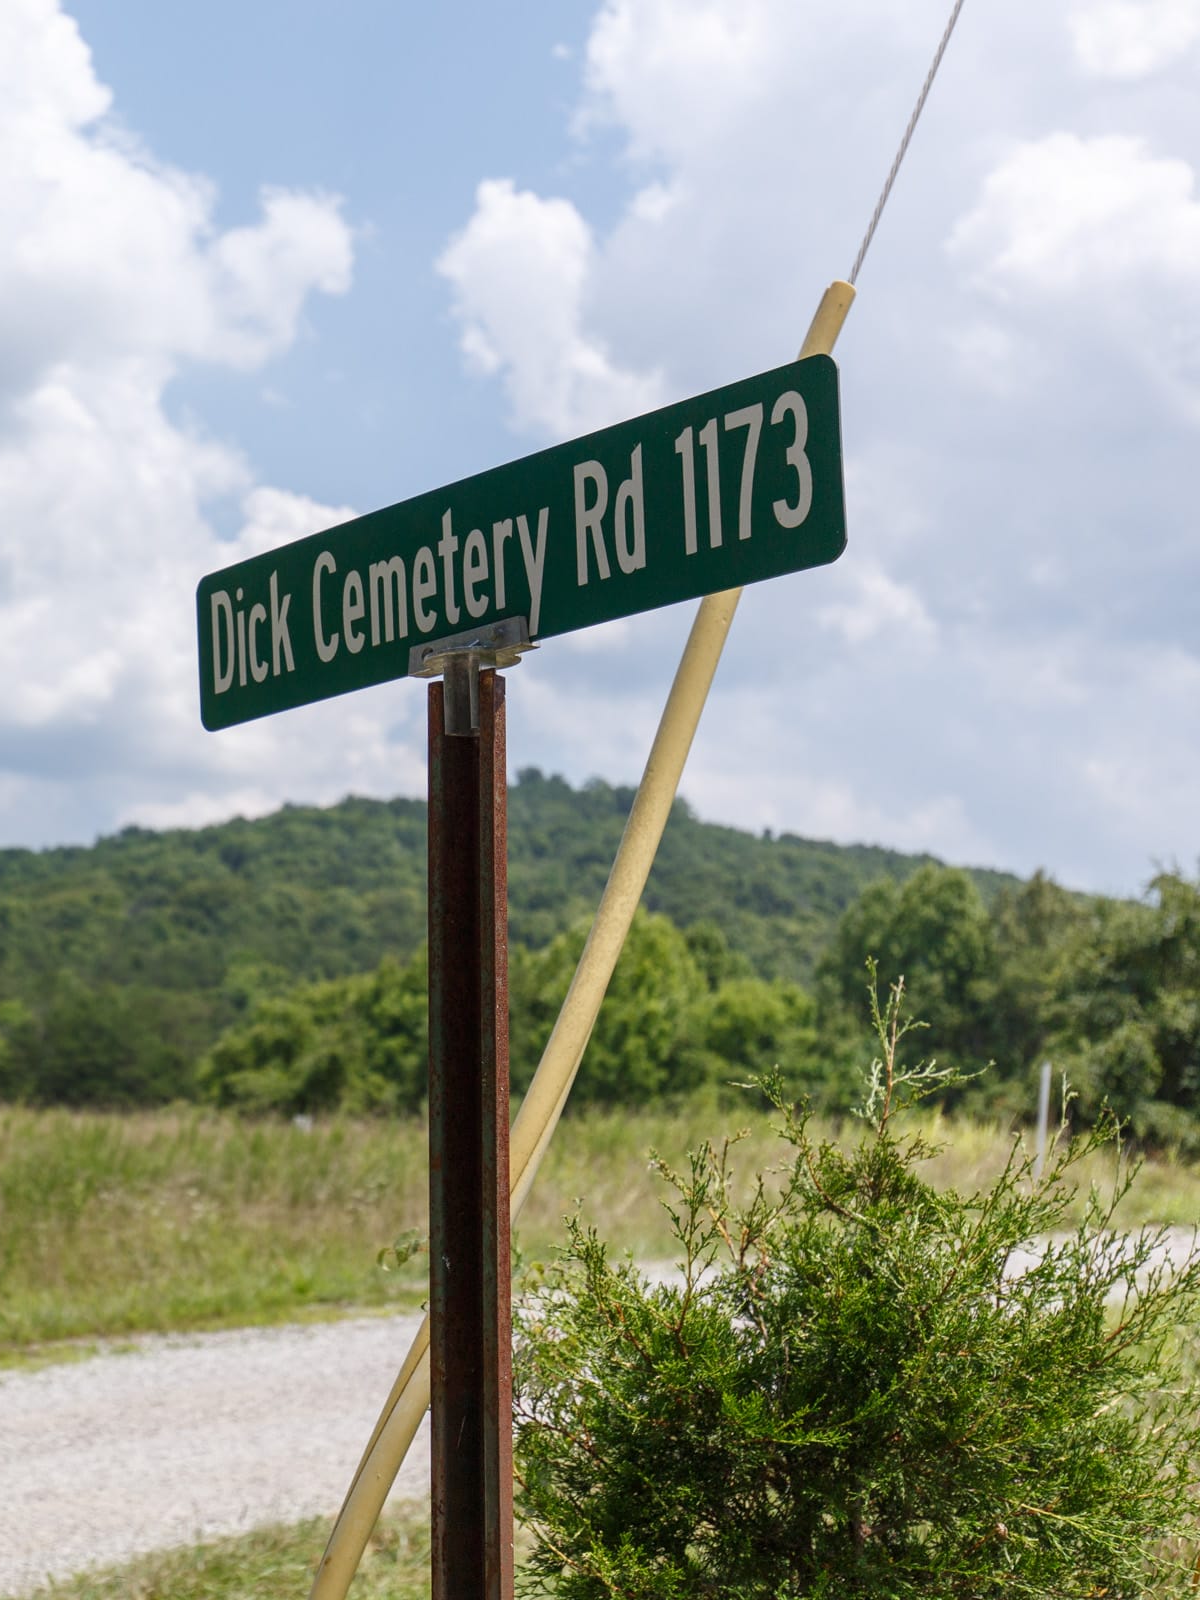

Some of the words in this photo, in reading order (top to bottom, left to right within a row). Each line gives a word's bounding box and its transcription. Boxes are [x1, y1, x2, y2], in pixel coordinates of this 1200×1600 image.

[211, 570, 295, 694] Dick
[312, 507, 549, 663] Cemetery
[573, 443, 646, 586] Rd
[675, 390, 813, 555] 1173
